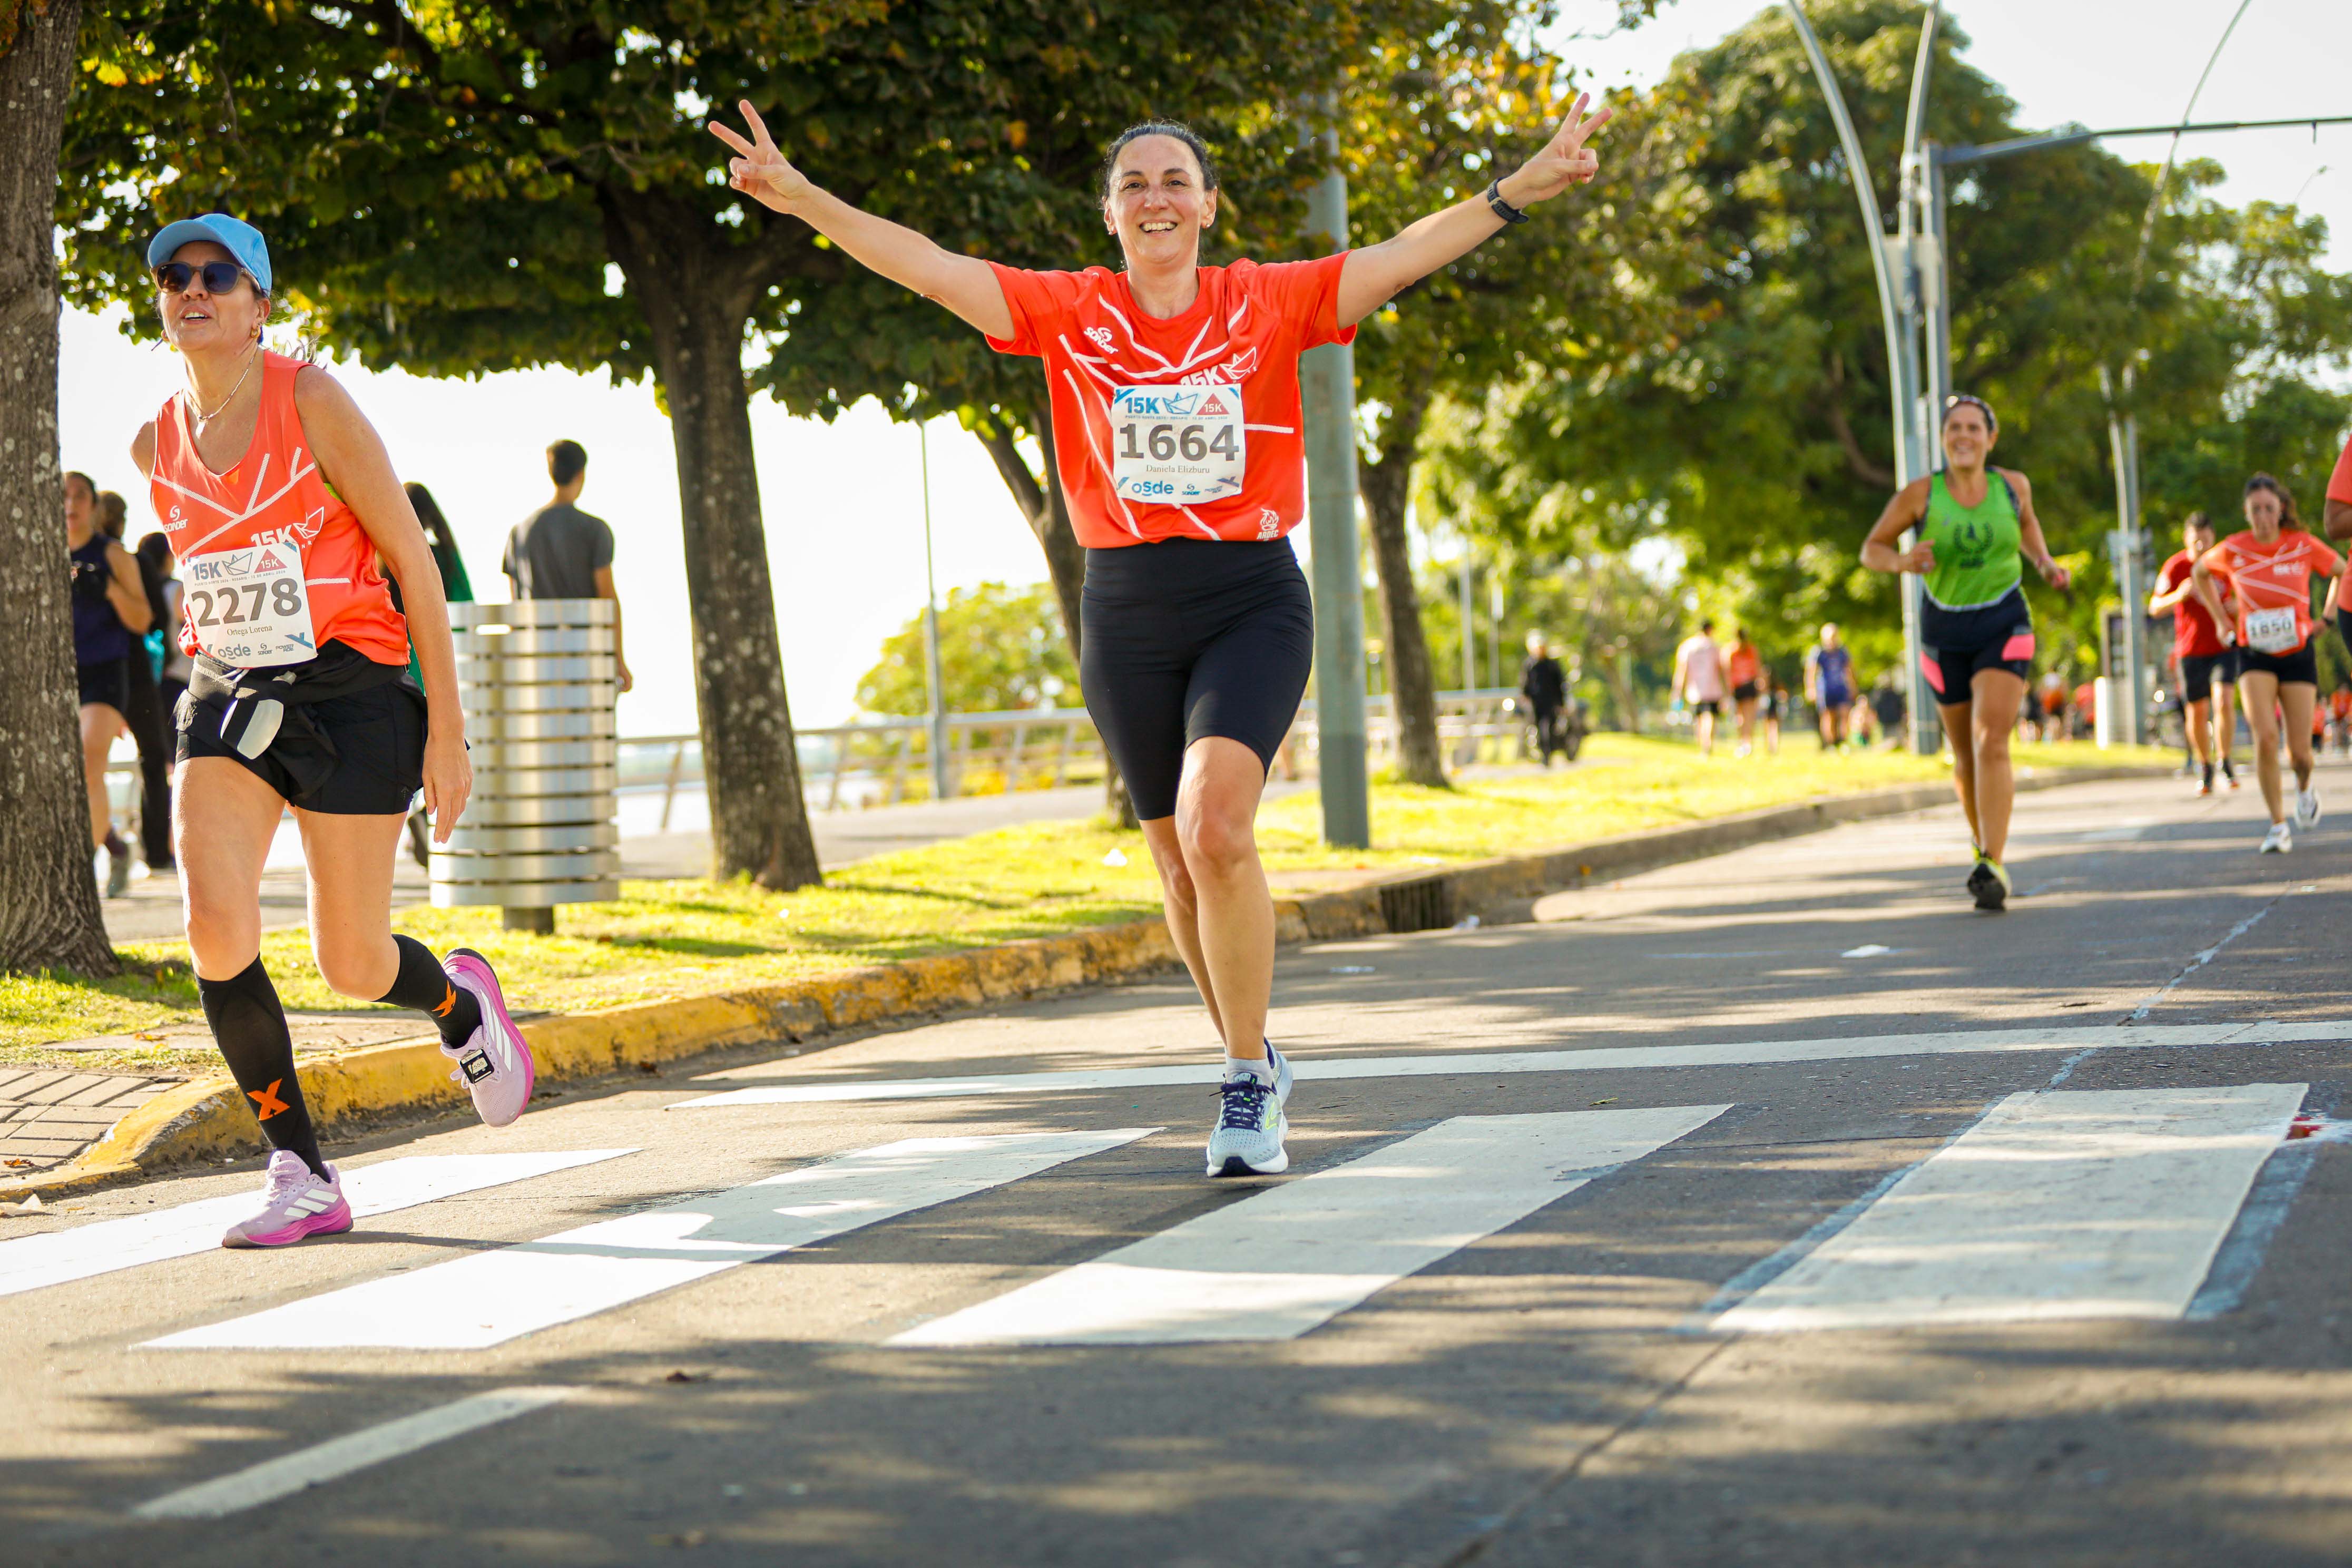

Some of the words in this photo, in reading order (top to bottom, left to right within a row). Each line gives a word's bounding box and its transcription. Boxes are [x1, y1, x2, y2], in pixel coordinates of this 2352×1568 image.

[1180, 365, 1226, 386] 15K
[1125, 397, 1160, 415] 15K
[1204, 403, 1222, 413] 15K
[1120, 424, 1239, 461] 1664
[1146, 464, 1175, 473] Daniela
[1131, 480, 1174, 495] osde
[250, 524, 296, 547] 15K
[1256, 529, 1279, 540] ARDEC
[193, 561, 222, 580] 15K
[260, 559, 279, 569] 15K
[191, 577, 302, 627] 2278
[249, 625, 272, 633] Lorena
[218, 643, 251, 659] osde
